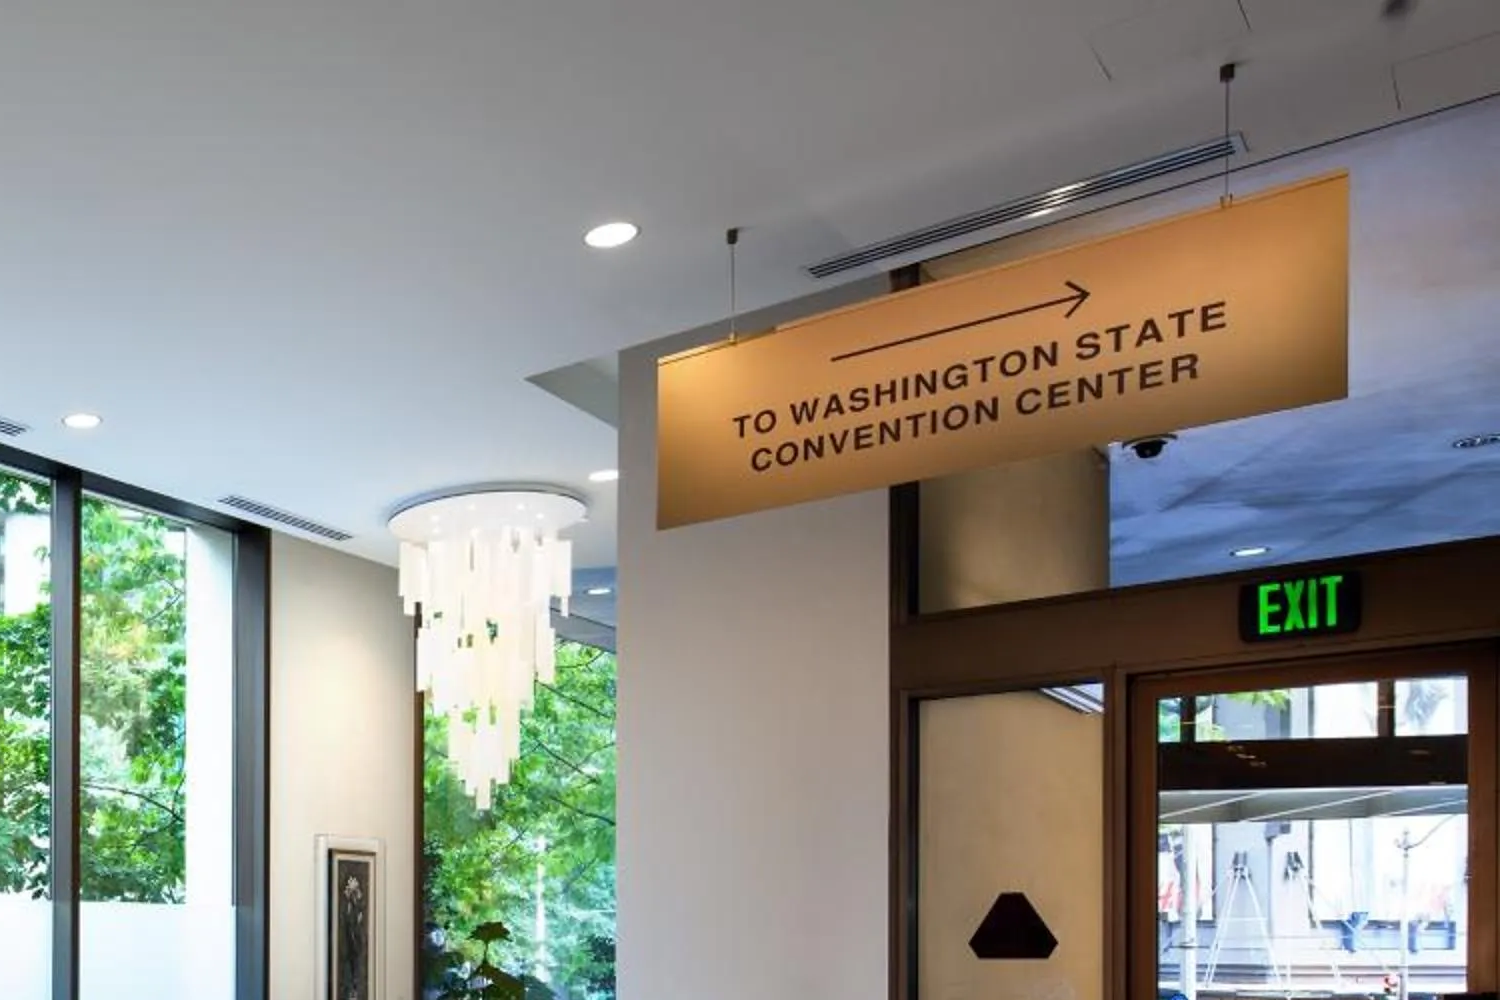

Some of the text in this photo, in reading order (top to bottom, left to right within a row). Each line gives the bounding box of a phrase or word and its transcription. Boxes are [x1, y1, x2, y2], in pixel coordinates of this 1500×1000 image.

[733, 301, 1227, 439] TO WASHINGTON STATE
[750, 353, 1199, 473] CONVENTION CENTER
[1258, 575, 1343, 635] EXIT
